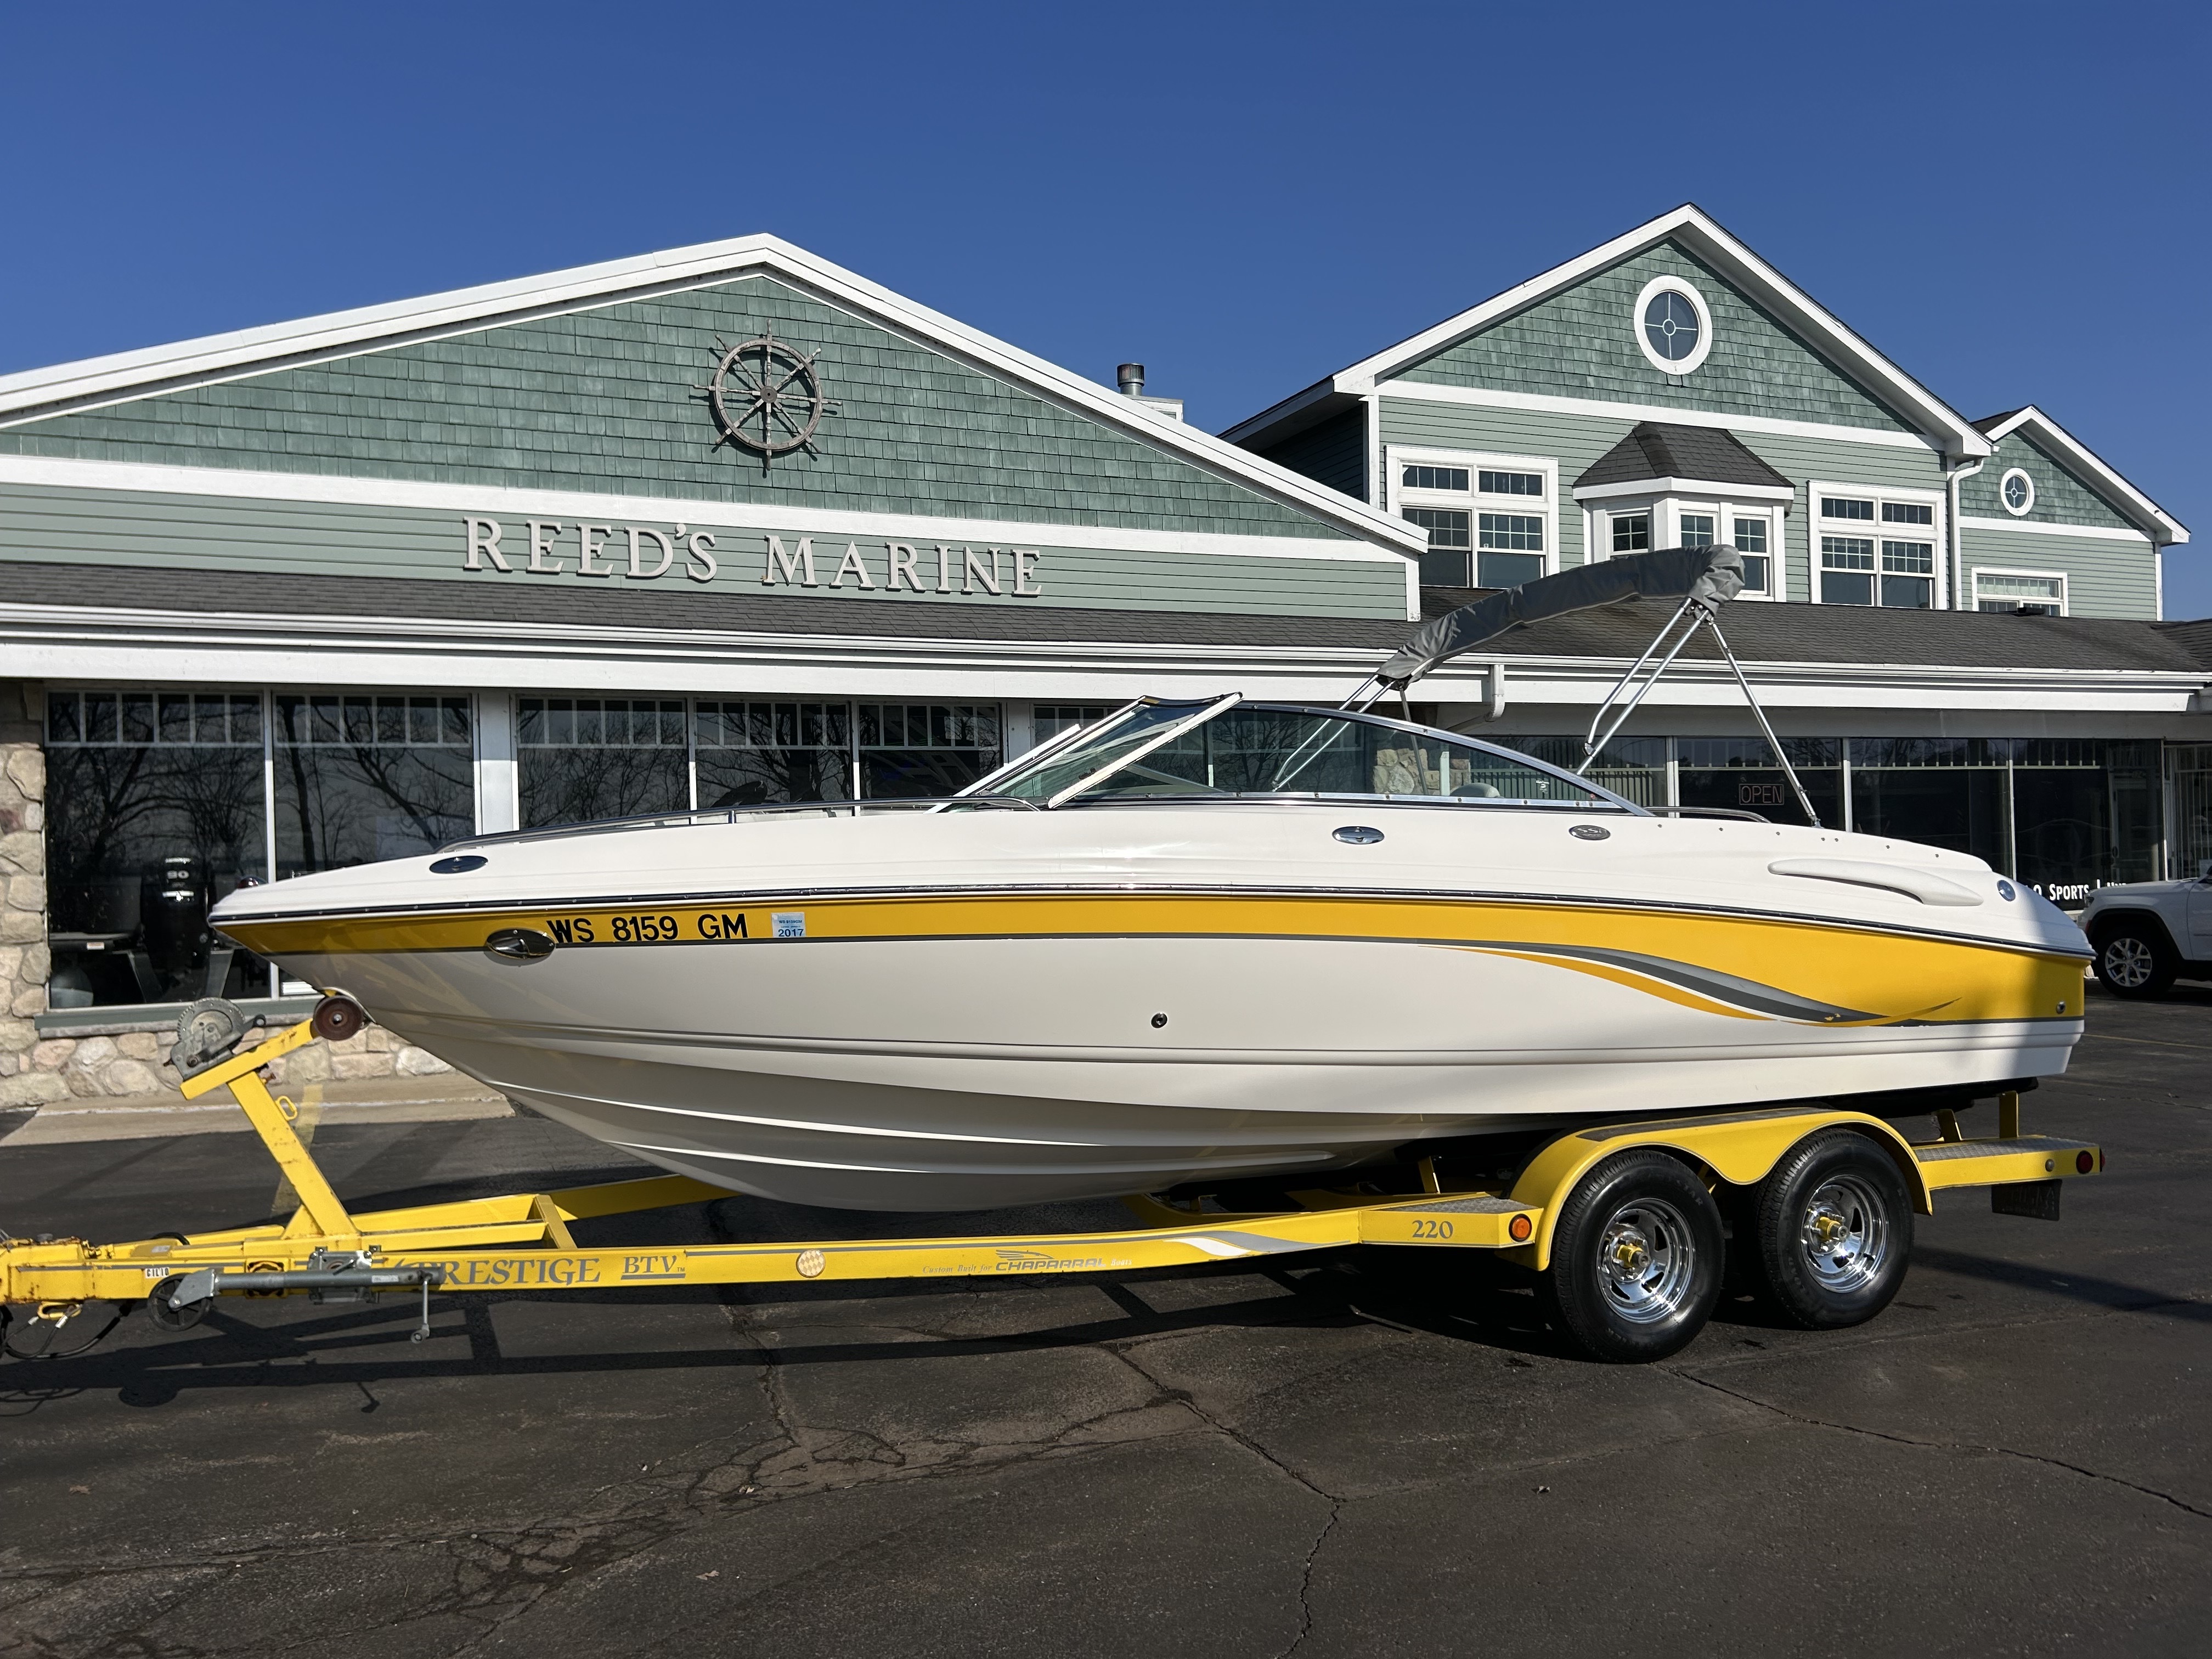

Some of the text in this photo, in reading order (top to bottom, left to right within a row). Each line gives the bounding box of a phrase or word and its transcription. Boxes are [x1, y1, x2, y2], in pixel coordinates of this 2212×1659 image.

[462, 515, 1042, 597] REED'S MARINE
[1741, 785, 1783, 804] OPEN
[546, 913, 748, 943] WS 8159 GM
[778, 928, 804, 937] 2017
[1412, 1220, 1454, 1239] 220
[922, 1265, 953, 1273] Custom
[957, 1264, 977, 1272] Built
[979, 1263, 992, 1273] for
[995, 1257, 1107, 1271] CHAPARRAL
